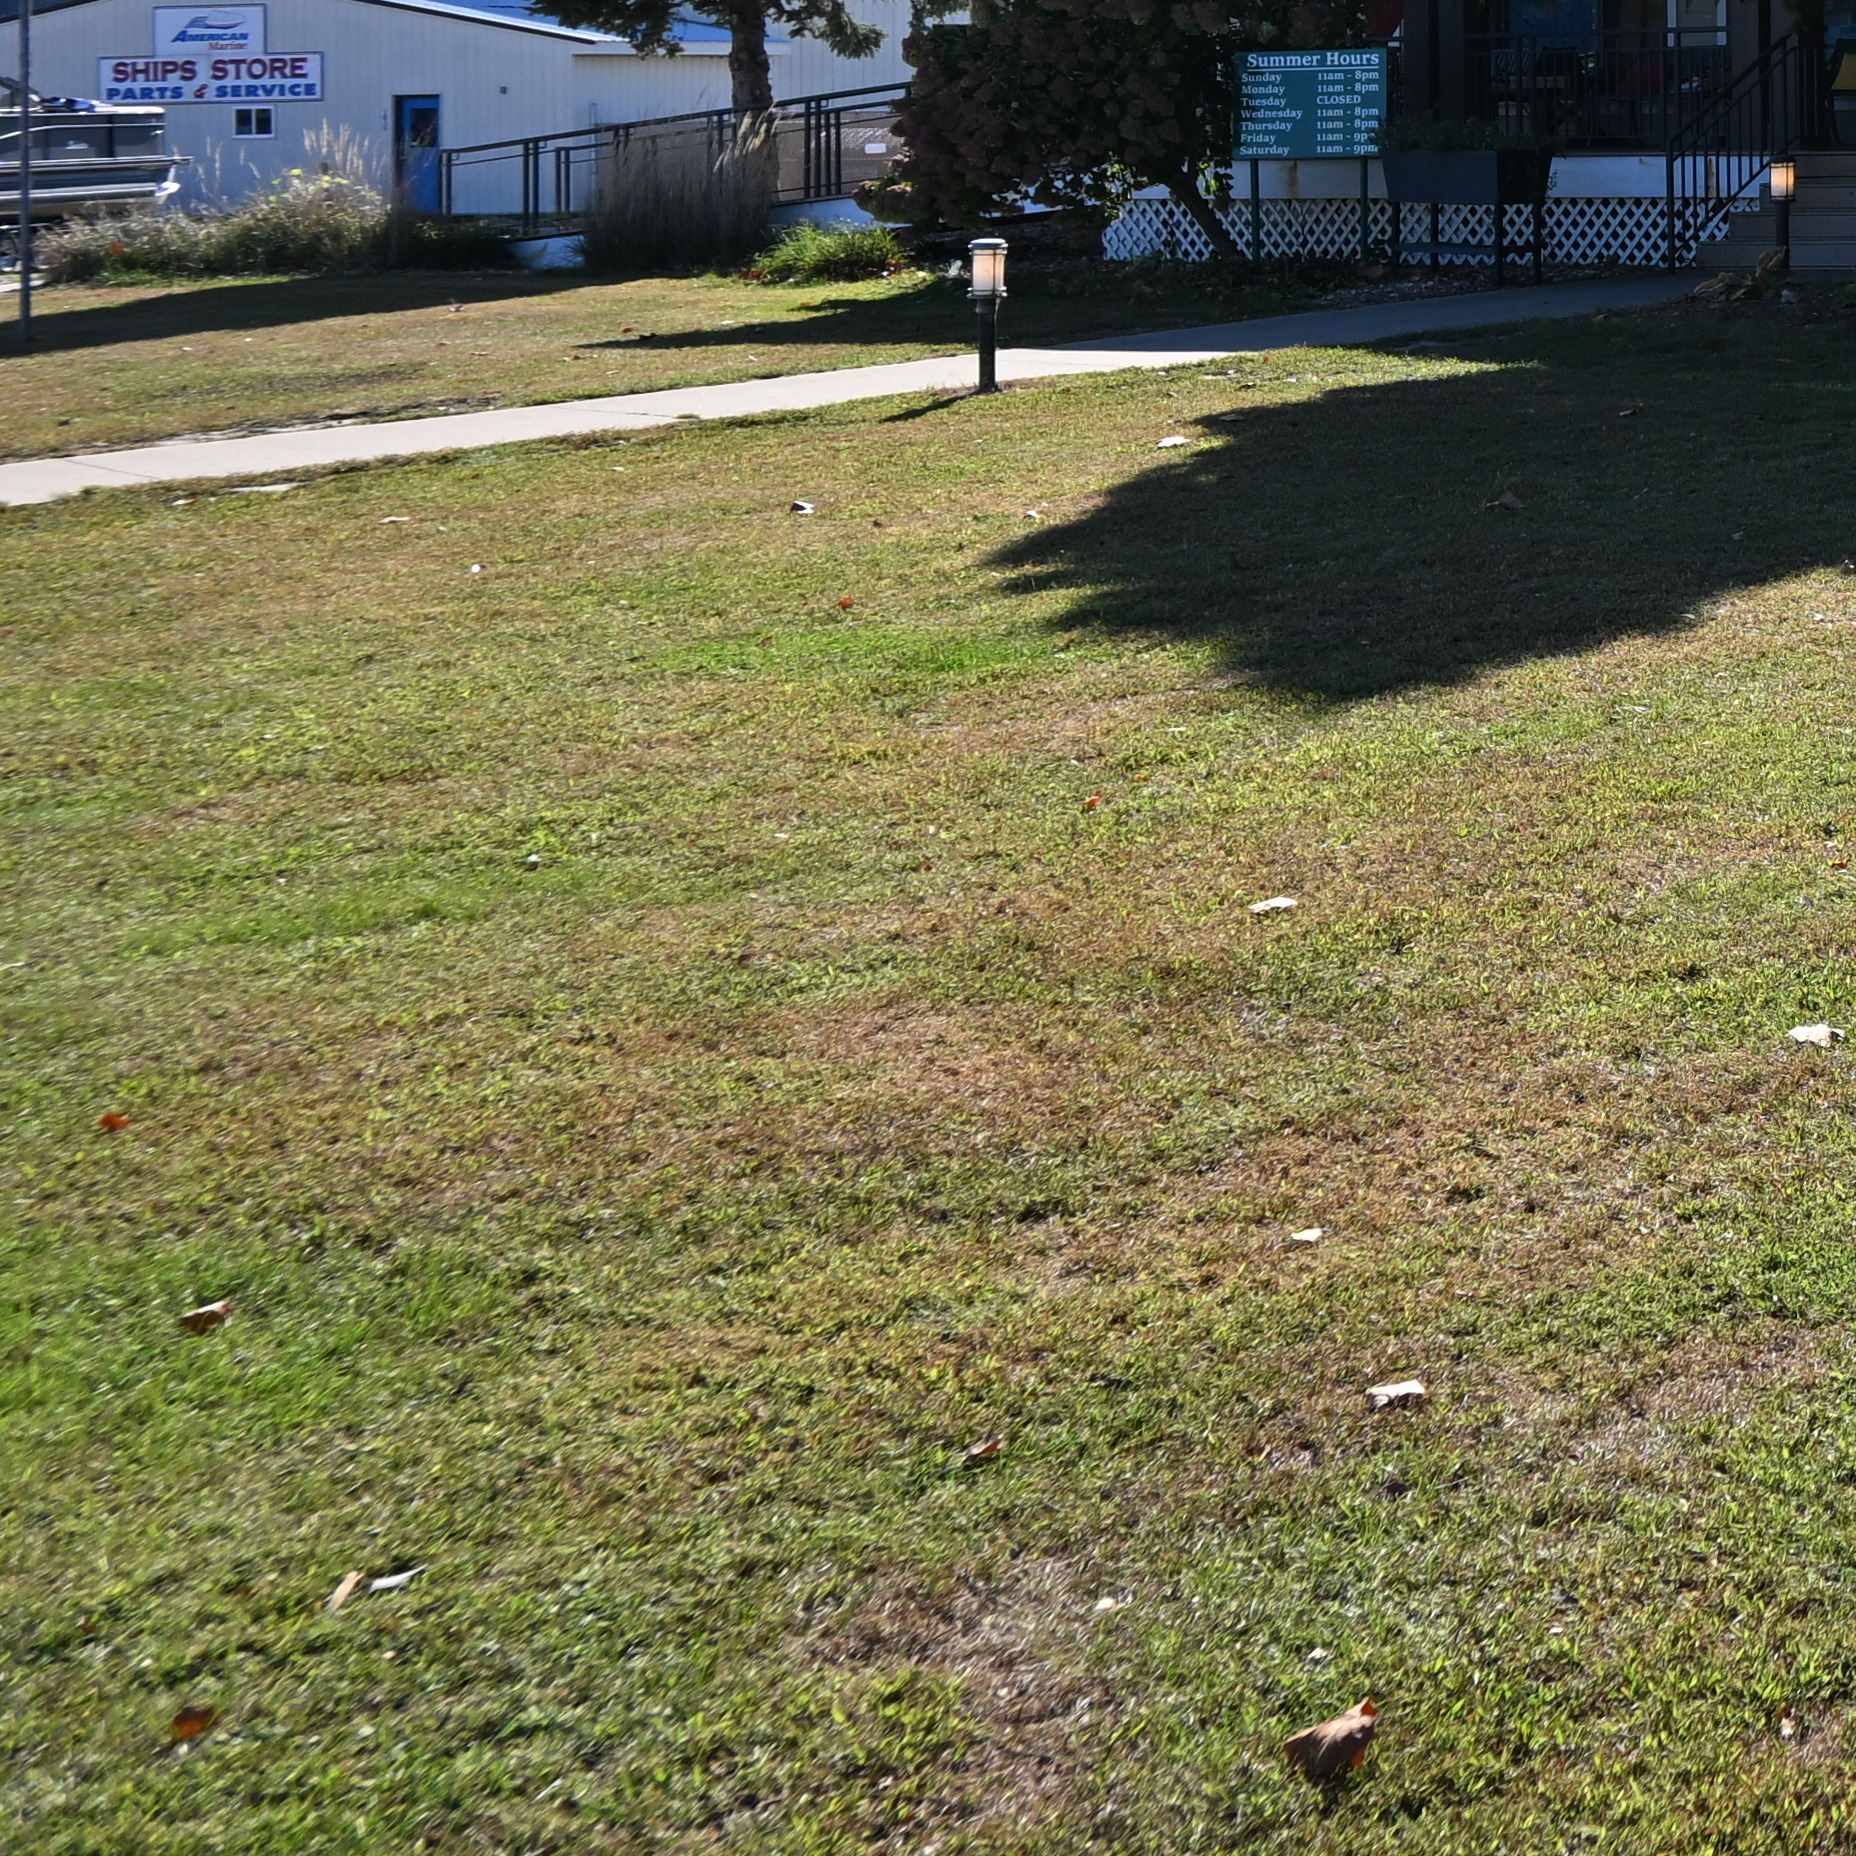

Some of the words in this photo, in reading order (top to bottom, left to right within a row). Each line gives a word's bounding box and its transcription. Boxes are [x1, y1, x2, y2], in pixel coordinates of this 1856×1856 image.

[171, 30, 248, 43] AMERICAN
[1247, 54, 1320, 67] Summer
[1325, 52, 1379, 65] Hours
[112, 60, 197, 83] SHIPS
[210, 57, 308, 81] STORE
[1241, 73, 1282, 84] Sunday
[1317, 72, 1344, 80] 11am
[1355, 70, 1379, 81] 8pm
[106, 85, 183, 101] PARTS
[193, 84, 208, 99] &
[214, 83, 317, 98] SERVICE
[1241, 85, 1285, 96] Monday
[1317, 84, 1344, 92] 11am
[1355, 82, 1379, 93] 8pm
[1240, 97, 1286, 107] Tuesday
[1316, 95, 1361, 105] CLOSED
[1240, 109, 1303, 119] Wednesday
[1317, 108, 1344, 117] 11am
[1354, 107, 1379, 118] 8pm
[1240, 121, 1293, 132] Thursday
[1316, 120, 1343, 129] 11am
[1354, 119, 1379, 130] 8pm
[1240, 133, 1276, 144] Friday
[1316, 132, 1343, 141] 11am
[1239, 145, 1289, 156] Saturday
[1316, 145, 1343, 153] 11am
